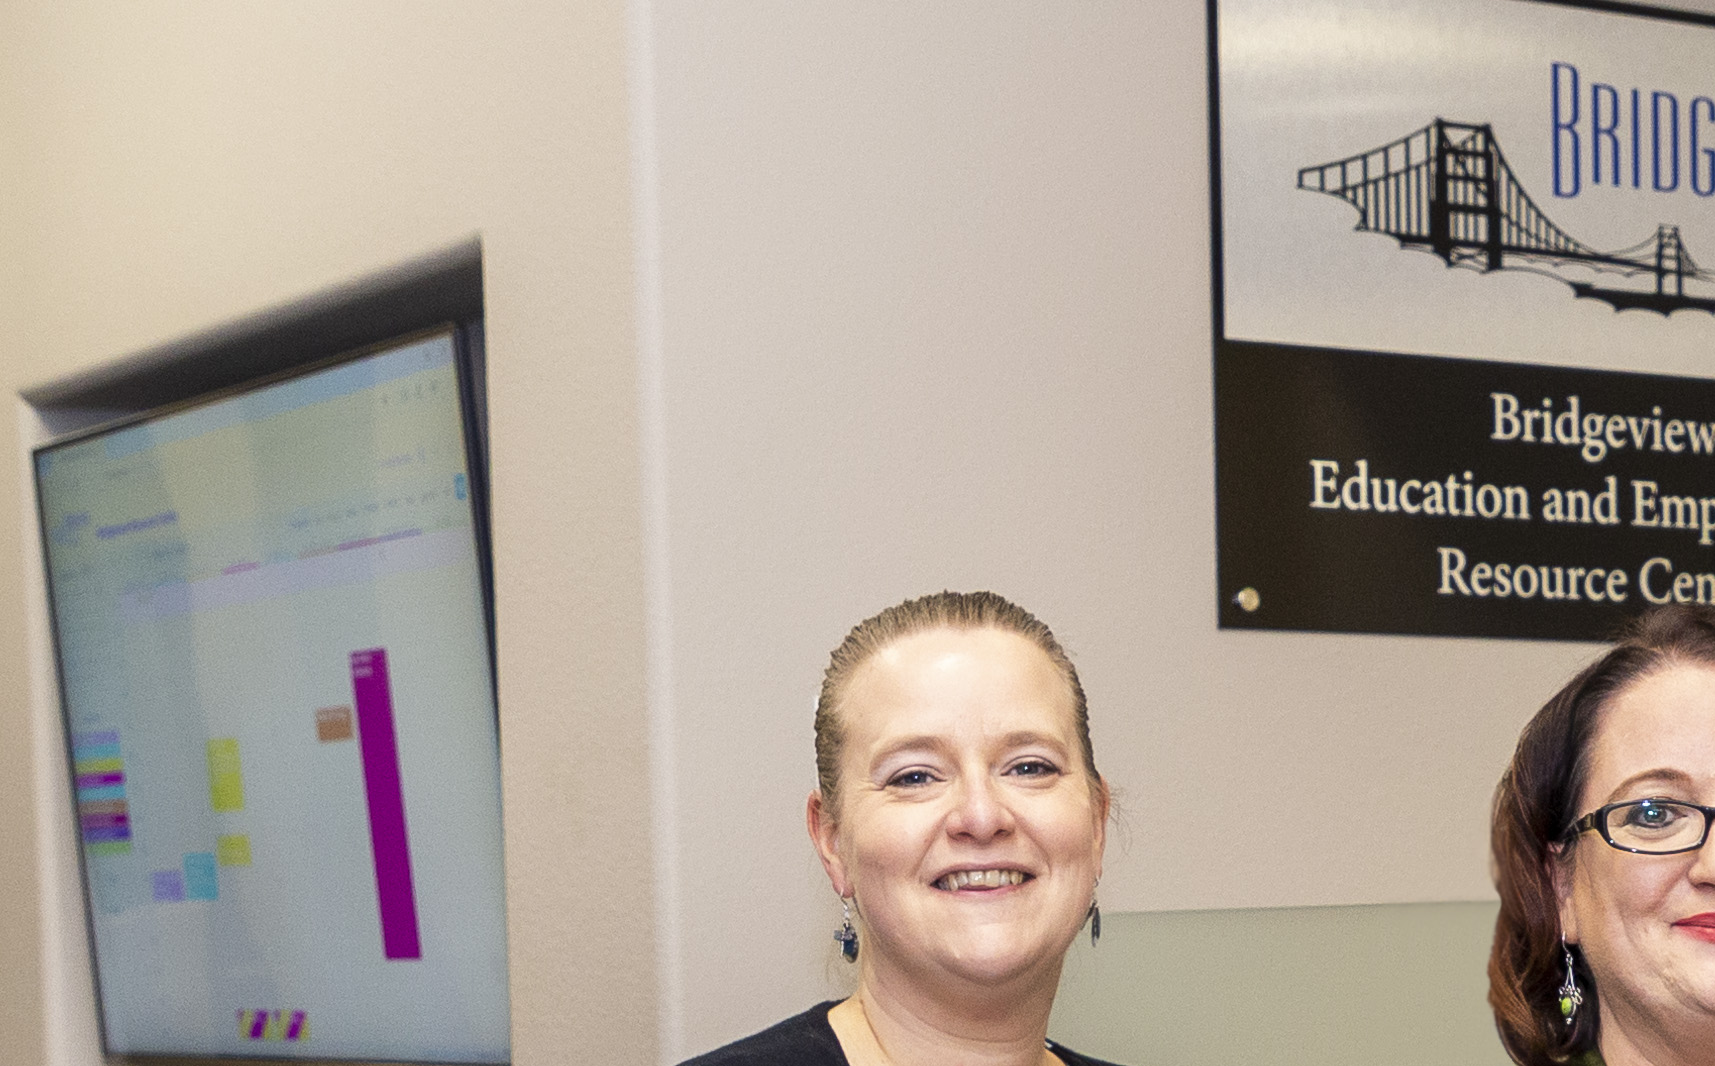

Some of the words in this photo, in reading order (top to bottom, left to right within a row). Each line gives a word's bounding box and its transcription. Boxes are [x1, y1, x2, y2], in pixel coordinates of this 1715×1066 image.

[1309, 459, 1530, 521] Education
[1543, 476, 1620, 525] and
[1437, 547, 1628, 601] Resource
